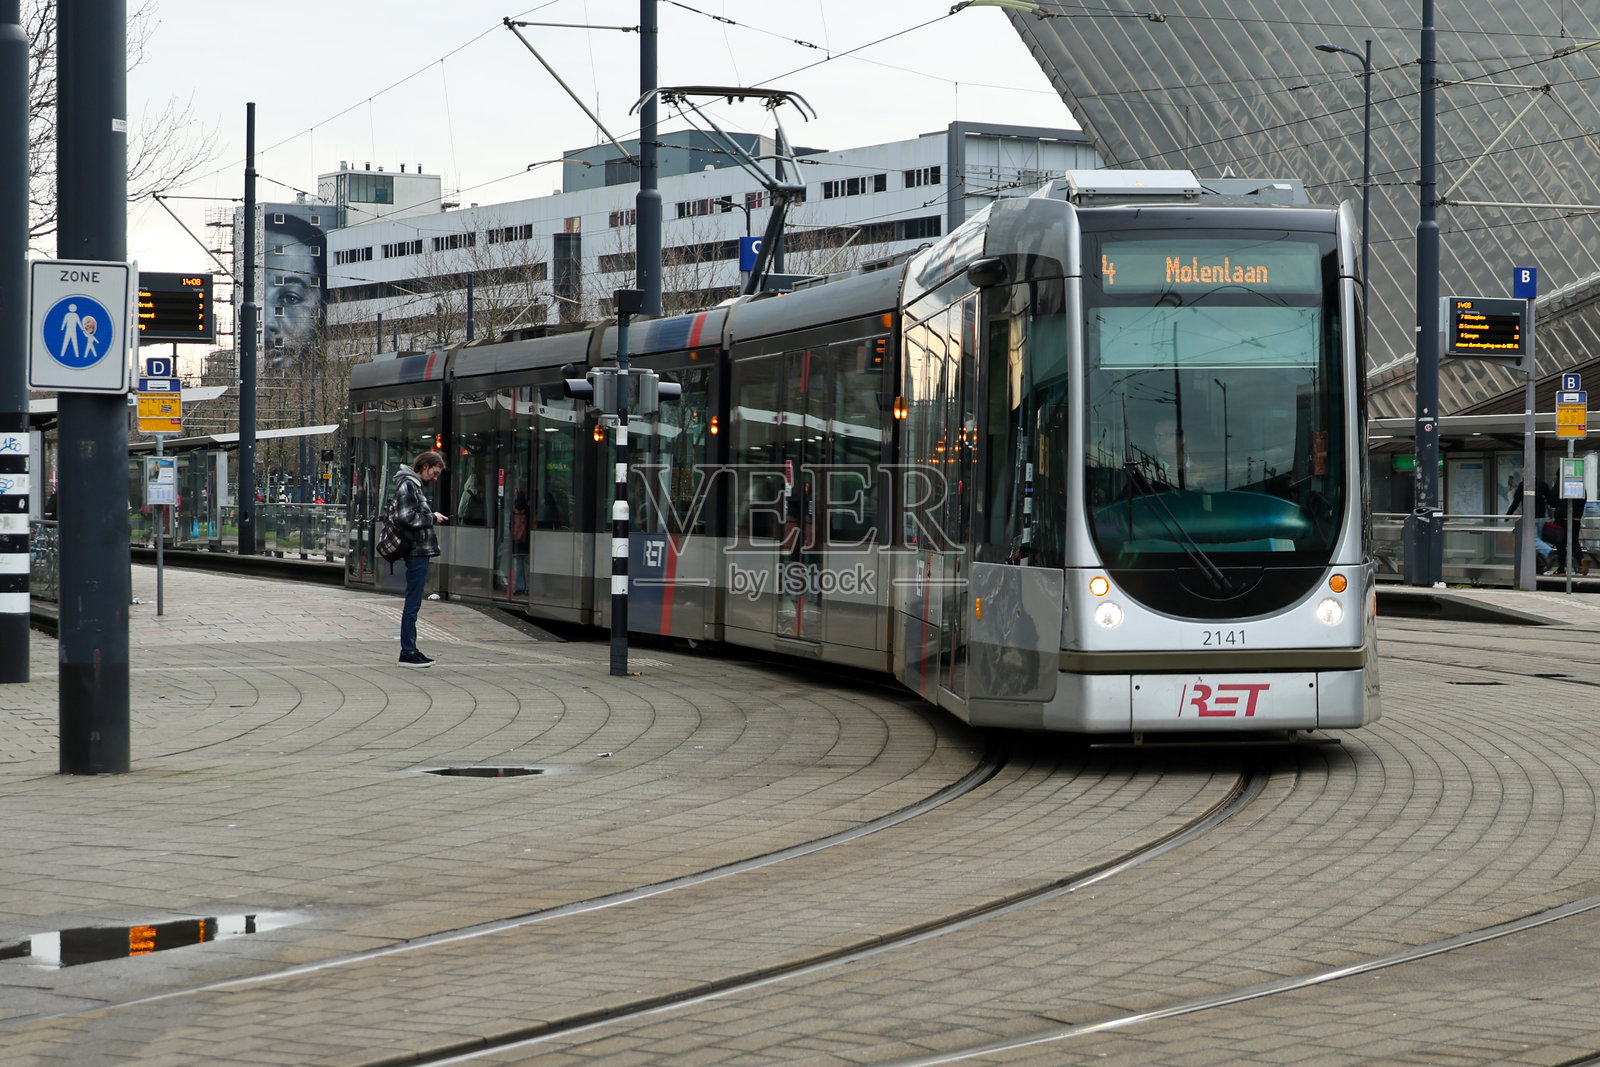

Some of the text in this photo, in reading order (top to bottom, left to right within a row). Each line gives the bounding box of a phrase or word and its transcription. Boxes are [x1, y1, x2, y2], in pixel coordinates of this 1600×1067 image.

[60, 270, 100, 283] ZONE
[1101, 254, 1269, 285] 4 Molenlaan
[1521, 270, 1531, 283] B
[152, 361, 165, 375] D
[1567, 377, 1576, 389] B
[1202, 630, 1247, 646] 2141
[1182, 683, 1270, 717] RET
